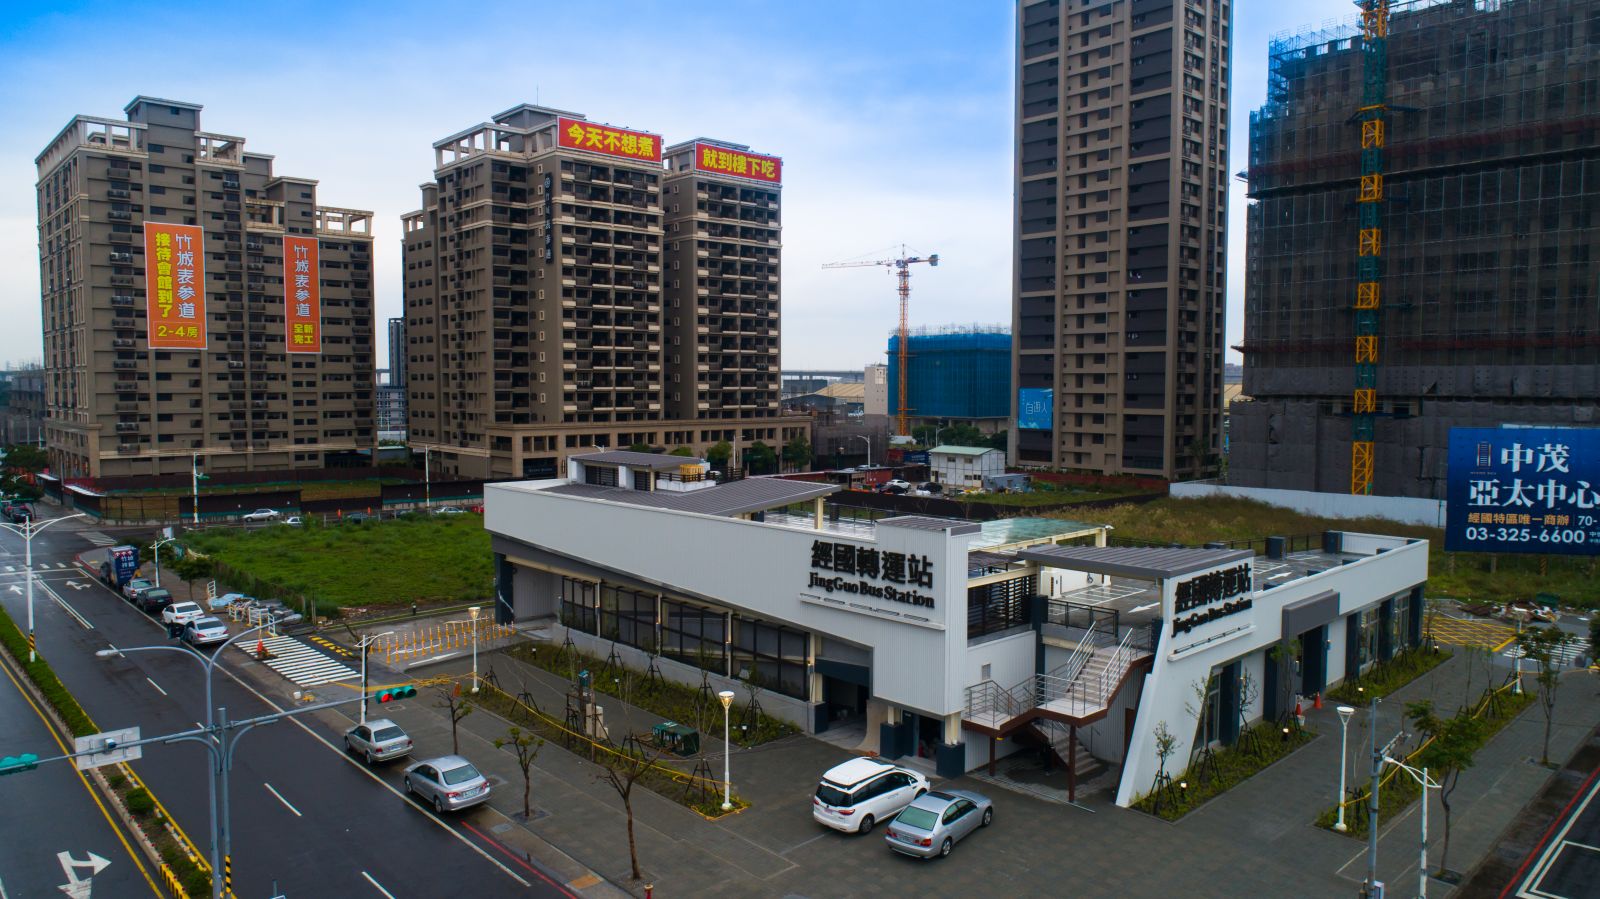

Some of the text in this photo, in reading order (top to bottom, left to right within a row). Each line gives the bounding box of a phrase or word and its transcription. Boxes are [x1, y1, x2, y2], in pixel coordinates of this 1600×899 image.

[568, 123, 654, 157] 今天不想煮
[703, 148, 775, 178] 就到樓下吃
[156, 232, 172, 317] 接待會館到了
[157, 325, 198, 338] 2-4房
[1500, 443, 1570, 473] 中茂
[1467, 478, 1600, 509] 亞太中心
[1467, 512, 1570, 526] 經國特區唯一商辦
[1466, 527, 1585, 543] 03-325-6600
[811, 539, 933, 588] 經國轉運站
[808, 571, 935, 608] JingGuo Bus Station
